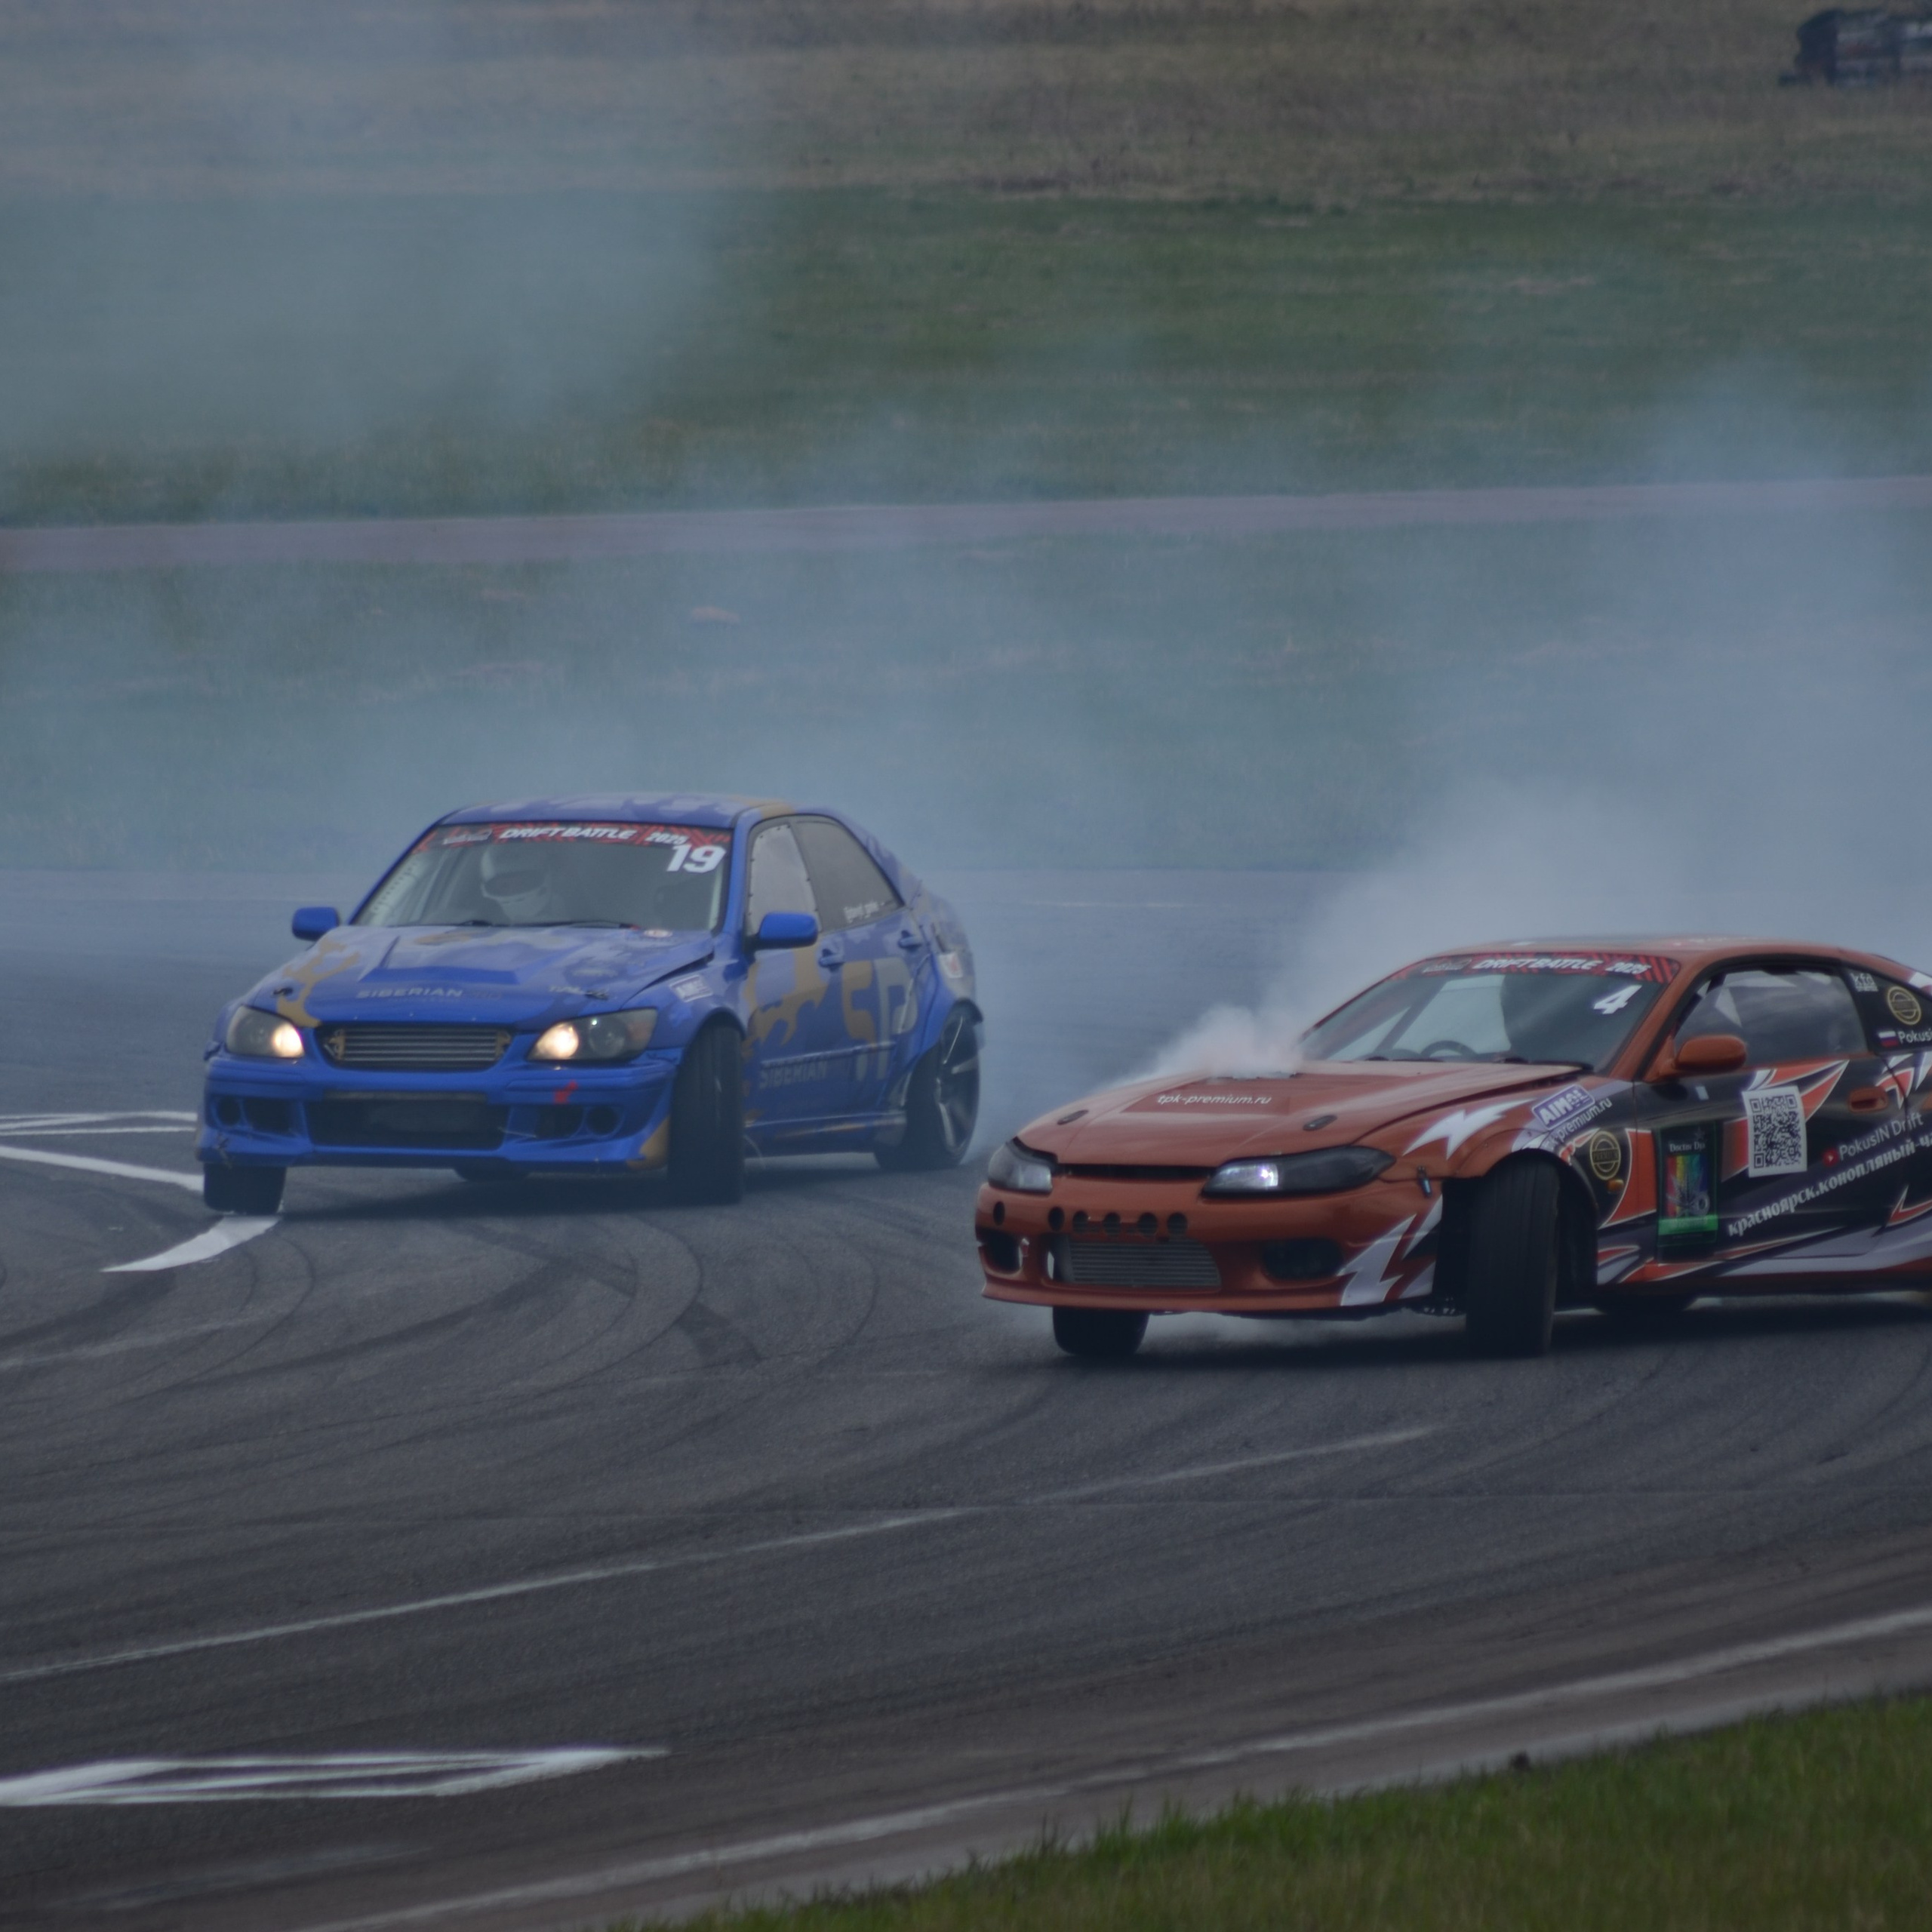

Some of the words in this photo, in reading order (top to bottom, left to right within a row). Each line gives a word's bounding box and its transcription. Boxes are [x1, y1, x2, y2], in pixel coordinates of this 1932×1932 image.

[498, 827, 567, 839] DRIFT
[561, 827, 638, 839] BATTLE
[666, 844, 727, 873] 19
[1472, 958, 1537, 970] DRIFT
[1529, 958, 1604, 970] BATTLE
[355, 988, 463, 998] SIBERIAN
[1593, 984, 1642, 1014] 4
[1157, 1094, 1272, 1105] tpk-premium.ru
[1891, 1112, 1924, 1137] Drift
[1727, 1131, 1932, 1238] красноярск.конопляный-ч
